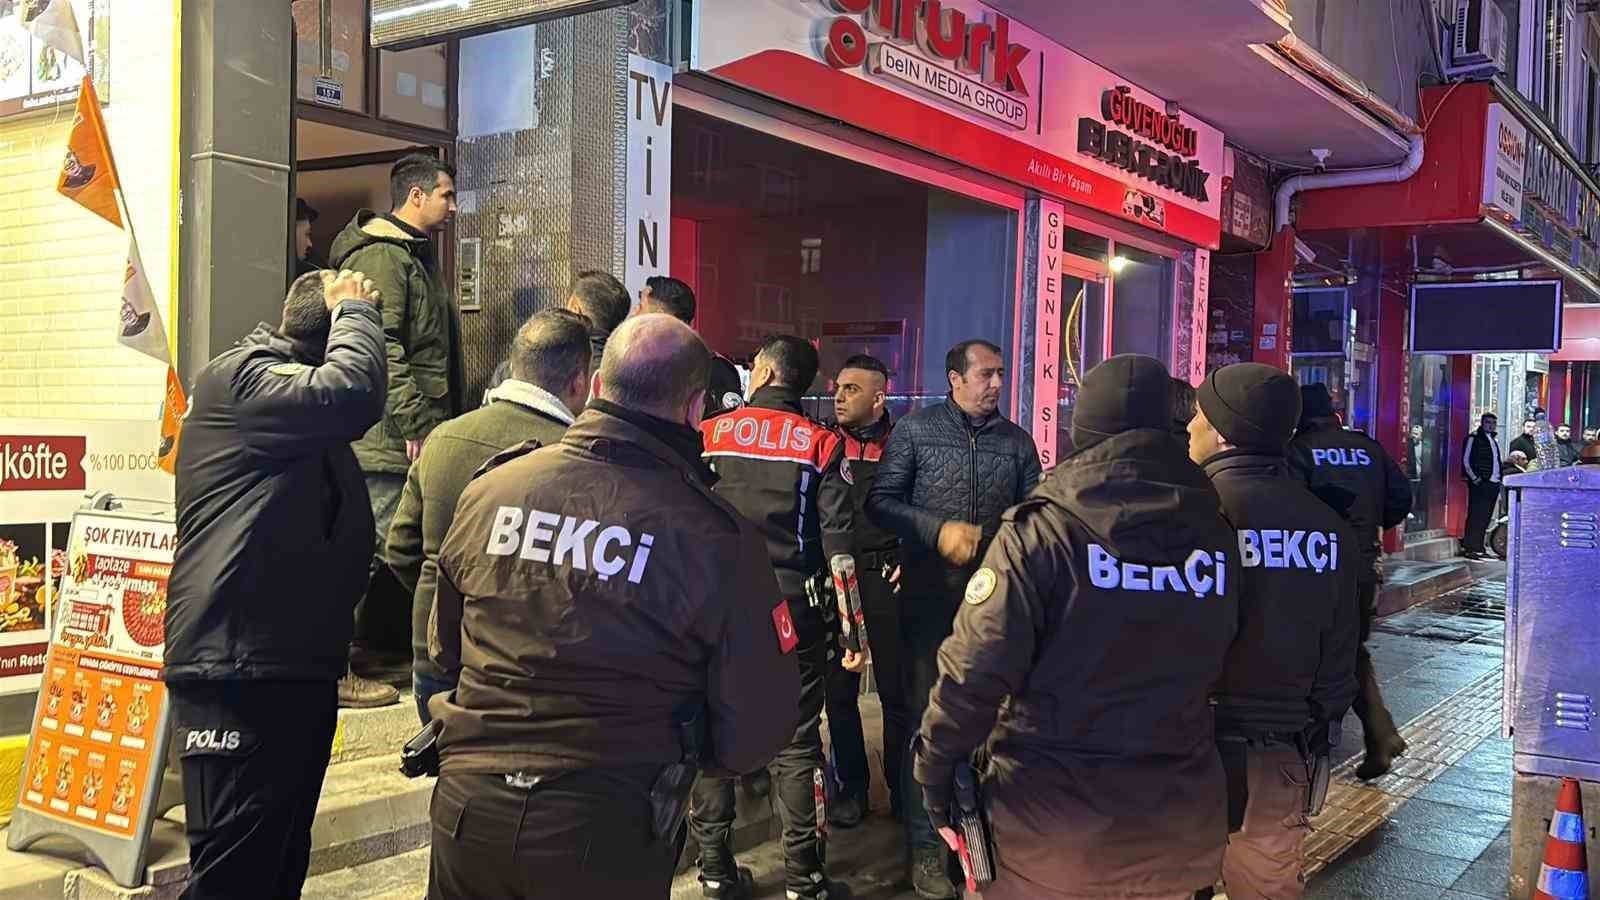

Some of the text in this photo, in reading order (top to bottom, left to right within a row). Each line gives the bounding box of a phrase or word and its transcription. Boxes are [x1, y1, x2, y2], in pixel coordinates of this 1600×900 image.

[630, 71, 671, 126] TV
[885, 51, 1024, 121] beIN MEDIA GROUP
[1027, 158, 1093, 195] Akıllı Bir Yaşam
[1042, 212, 1059, 379] GÜVENLİK
[712, 416, 814, 452] POLİS
[89, 451, 160, 472] %100 DOĞ
[84, 526, 111, 546] ŞOK
[485, 505, 655, 585] BEKÇİ
[1237, 528, 1338, 574] BEKÇİ
[94, 555, 130, 574] taptaze
